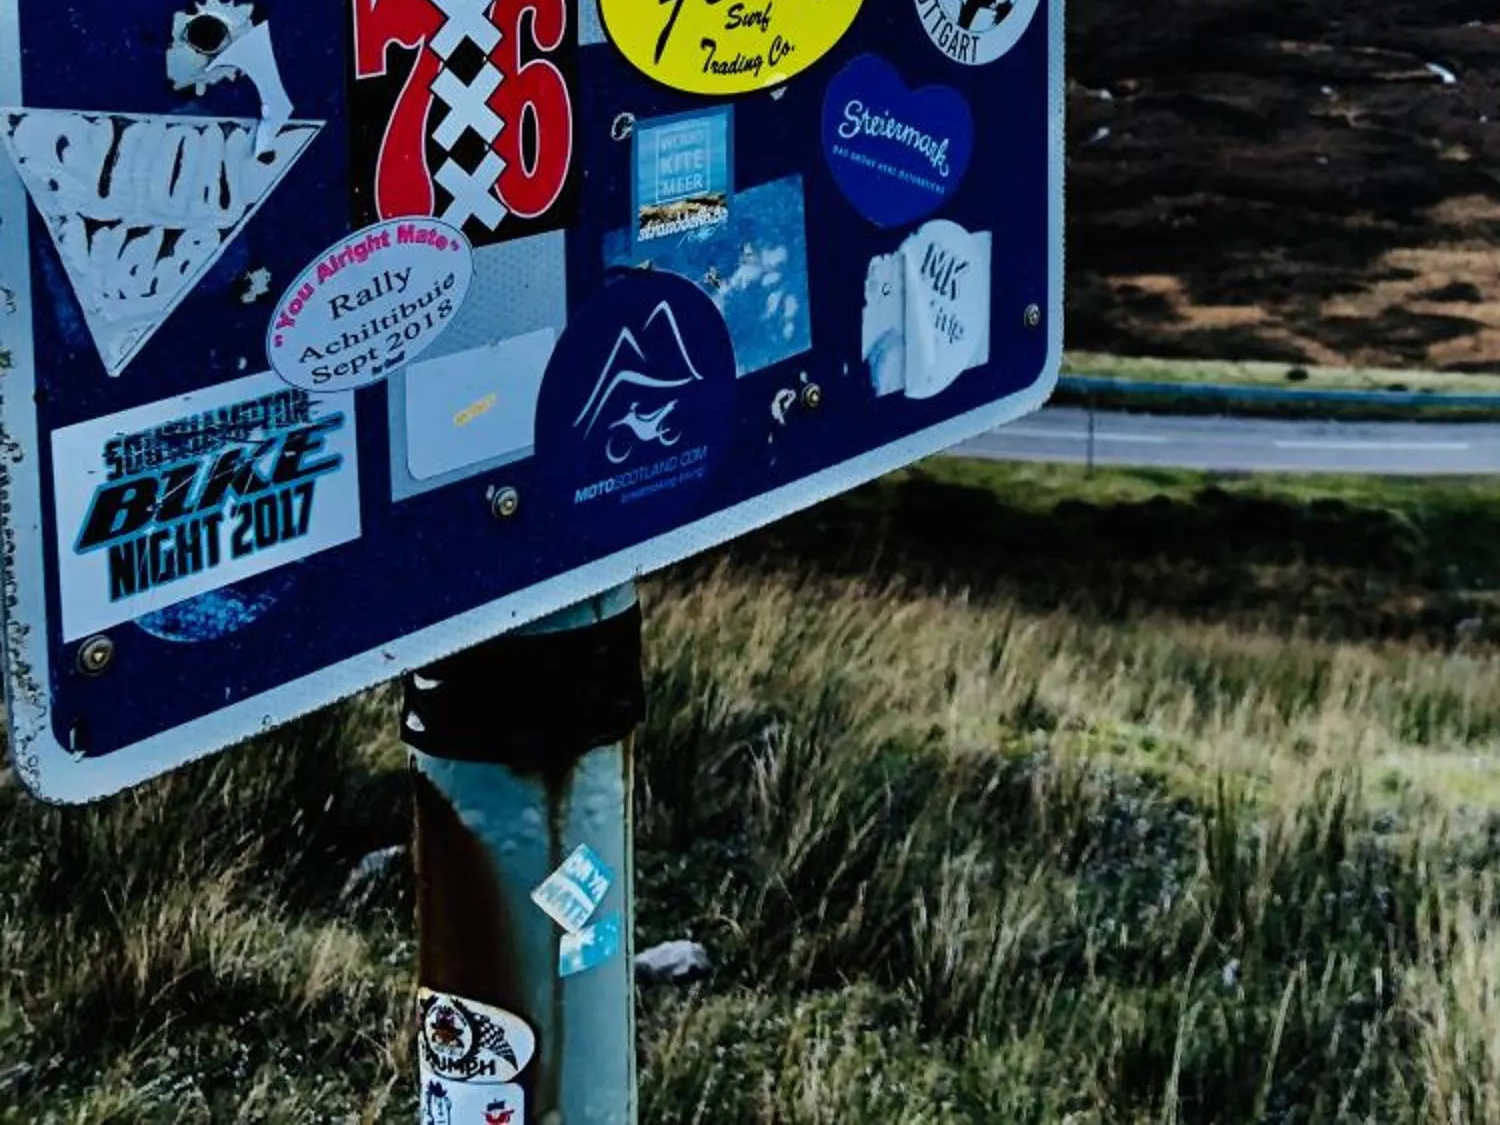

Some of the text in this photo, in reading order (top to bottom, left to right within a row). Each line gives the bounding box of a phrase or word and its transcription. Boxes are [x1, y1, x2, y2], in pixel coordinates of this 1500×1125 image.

[724, 1, 773, 32] Surf
[700, 35, 796, 77] Trading Co.
[837, 100, 950, 178] Steiermark
[661, 173, 705, 197] MEER
[314, 229, 392, 283] Alright
[299, 272, 456, 363] Achiltibuie
[328, 266, 413, 321] Rally
[311, 346, 378, 385] Sept
[385, 298, 454, 352] 2018
[73, 411, 347, 556] BIKE
[109, 479, 317, 604] NIGHT 2017
